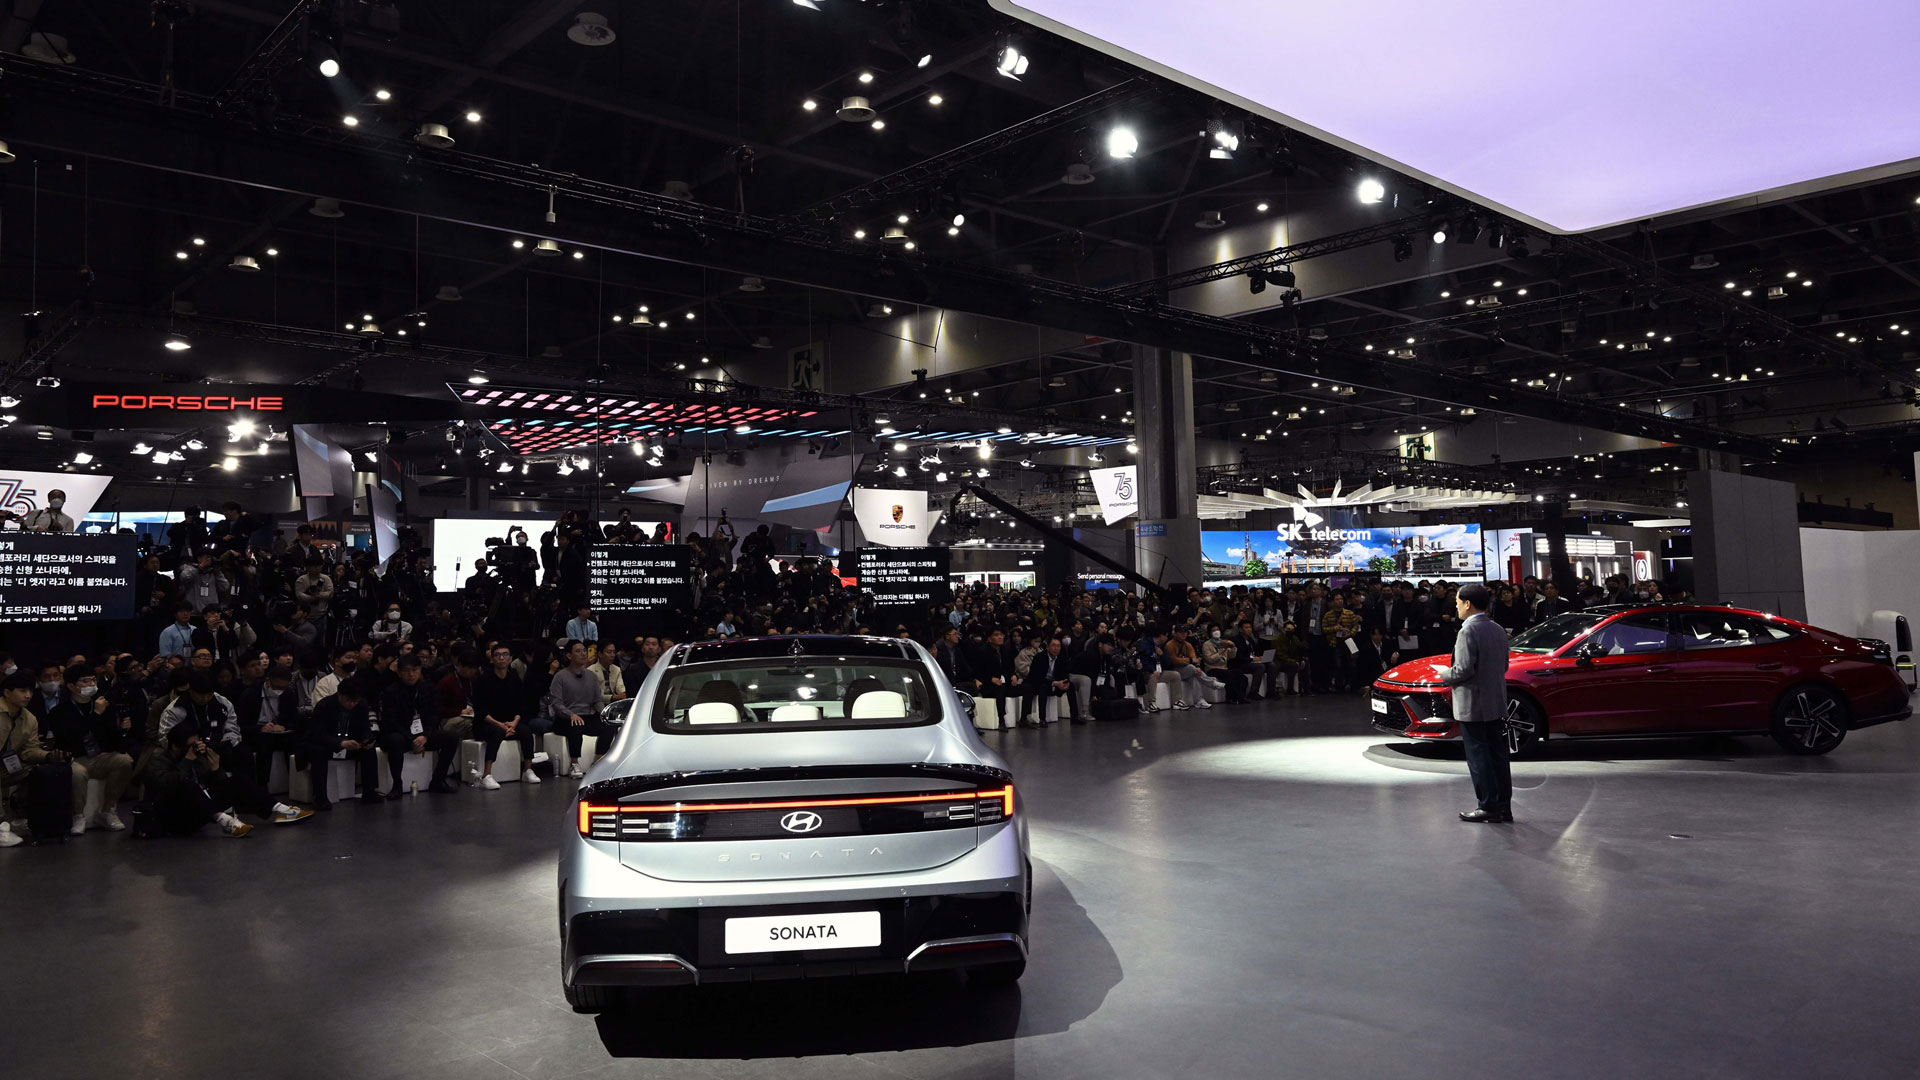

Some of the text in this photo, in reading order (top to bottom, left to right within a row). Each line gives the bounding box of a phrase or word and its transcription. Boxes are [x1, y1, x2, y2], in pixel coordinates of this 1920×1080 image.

[93, 395, 283, 410] PORSCHE
[699, 475, 780, 491] DIVEN BY DREAMS
[1114, 472, 1133, 500] 75
[0, 478, 37, 519] 75
[1276, 523, 1371, 541] SK telecom
[33, 554, 82, 563] 세단으로서의
[85, 555, 116, 564] 스피릿을
[16, 566, 32, 574] 신형
[35, 566, 71, 575] 쏘나타에,
[68, 578, 84, 586] 이름
[87, 578, 127, 586] 붙였습니다.
[5, 606, 48, 614] 도드라지는
[51, 605, 75, 614] 디테일
[78, 605, 101, 613] 하나가
[718, 847, 883, 862] SONATA
[769, 925, 838, 941] SONATA
